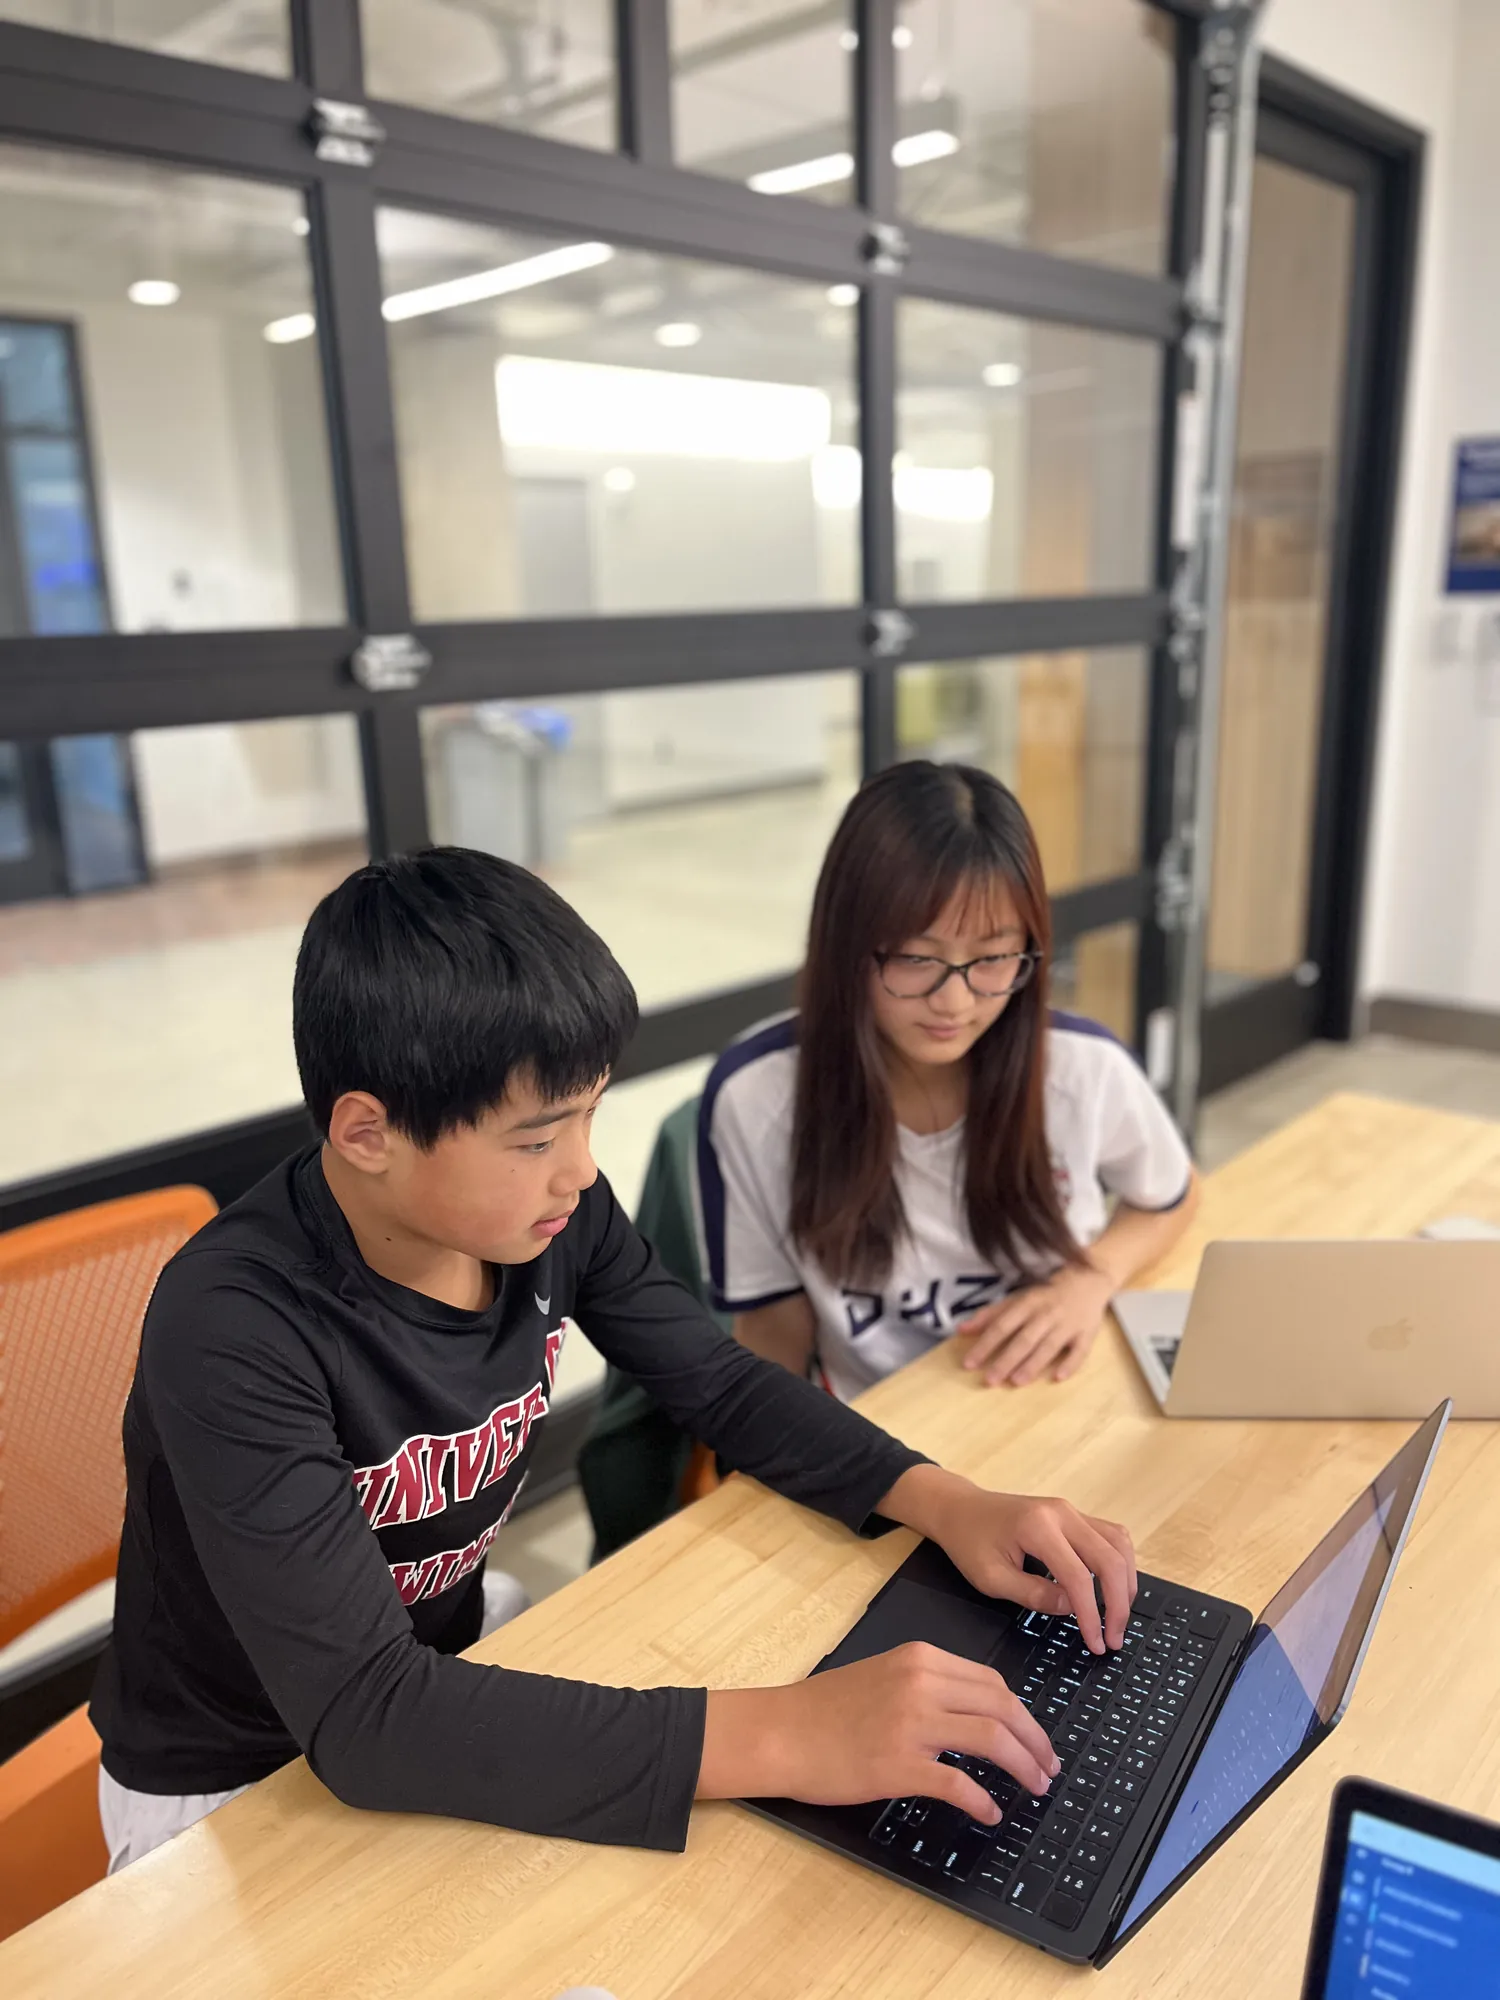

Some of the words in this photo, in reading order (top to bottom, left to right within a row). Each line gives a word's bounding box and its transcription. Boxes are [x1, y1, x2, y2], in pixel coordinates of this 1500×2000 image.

[353, 1336, 561, 1530] UNIVER
[912, 1840, 924, 1853] shift
[945, 1851, 958, 1868] return
[1012, 1882, 1025, 1899] delete
